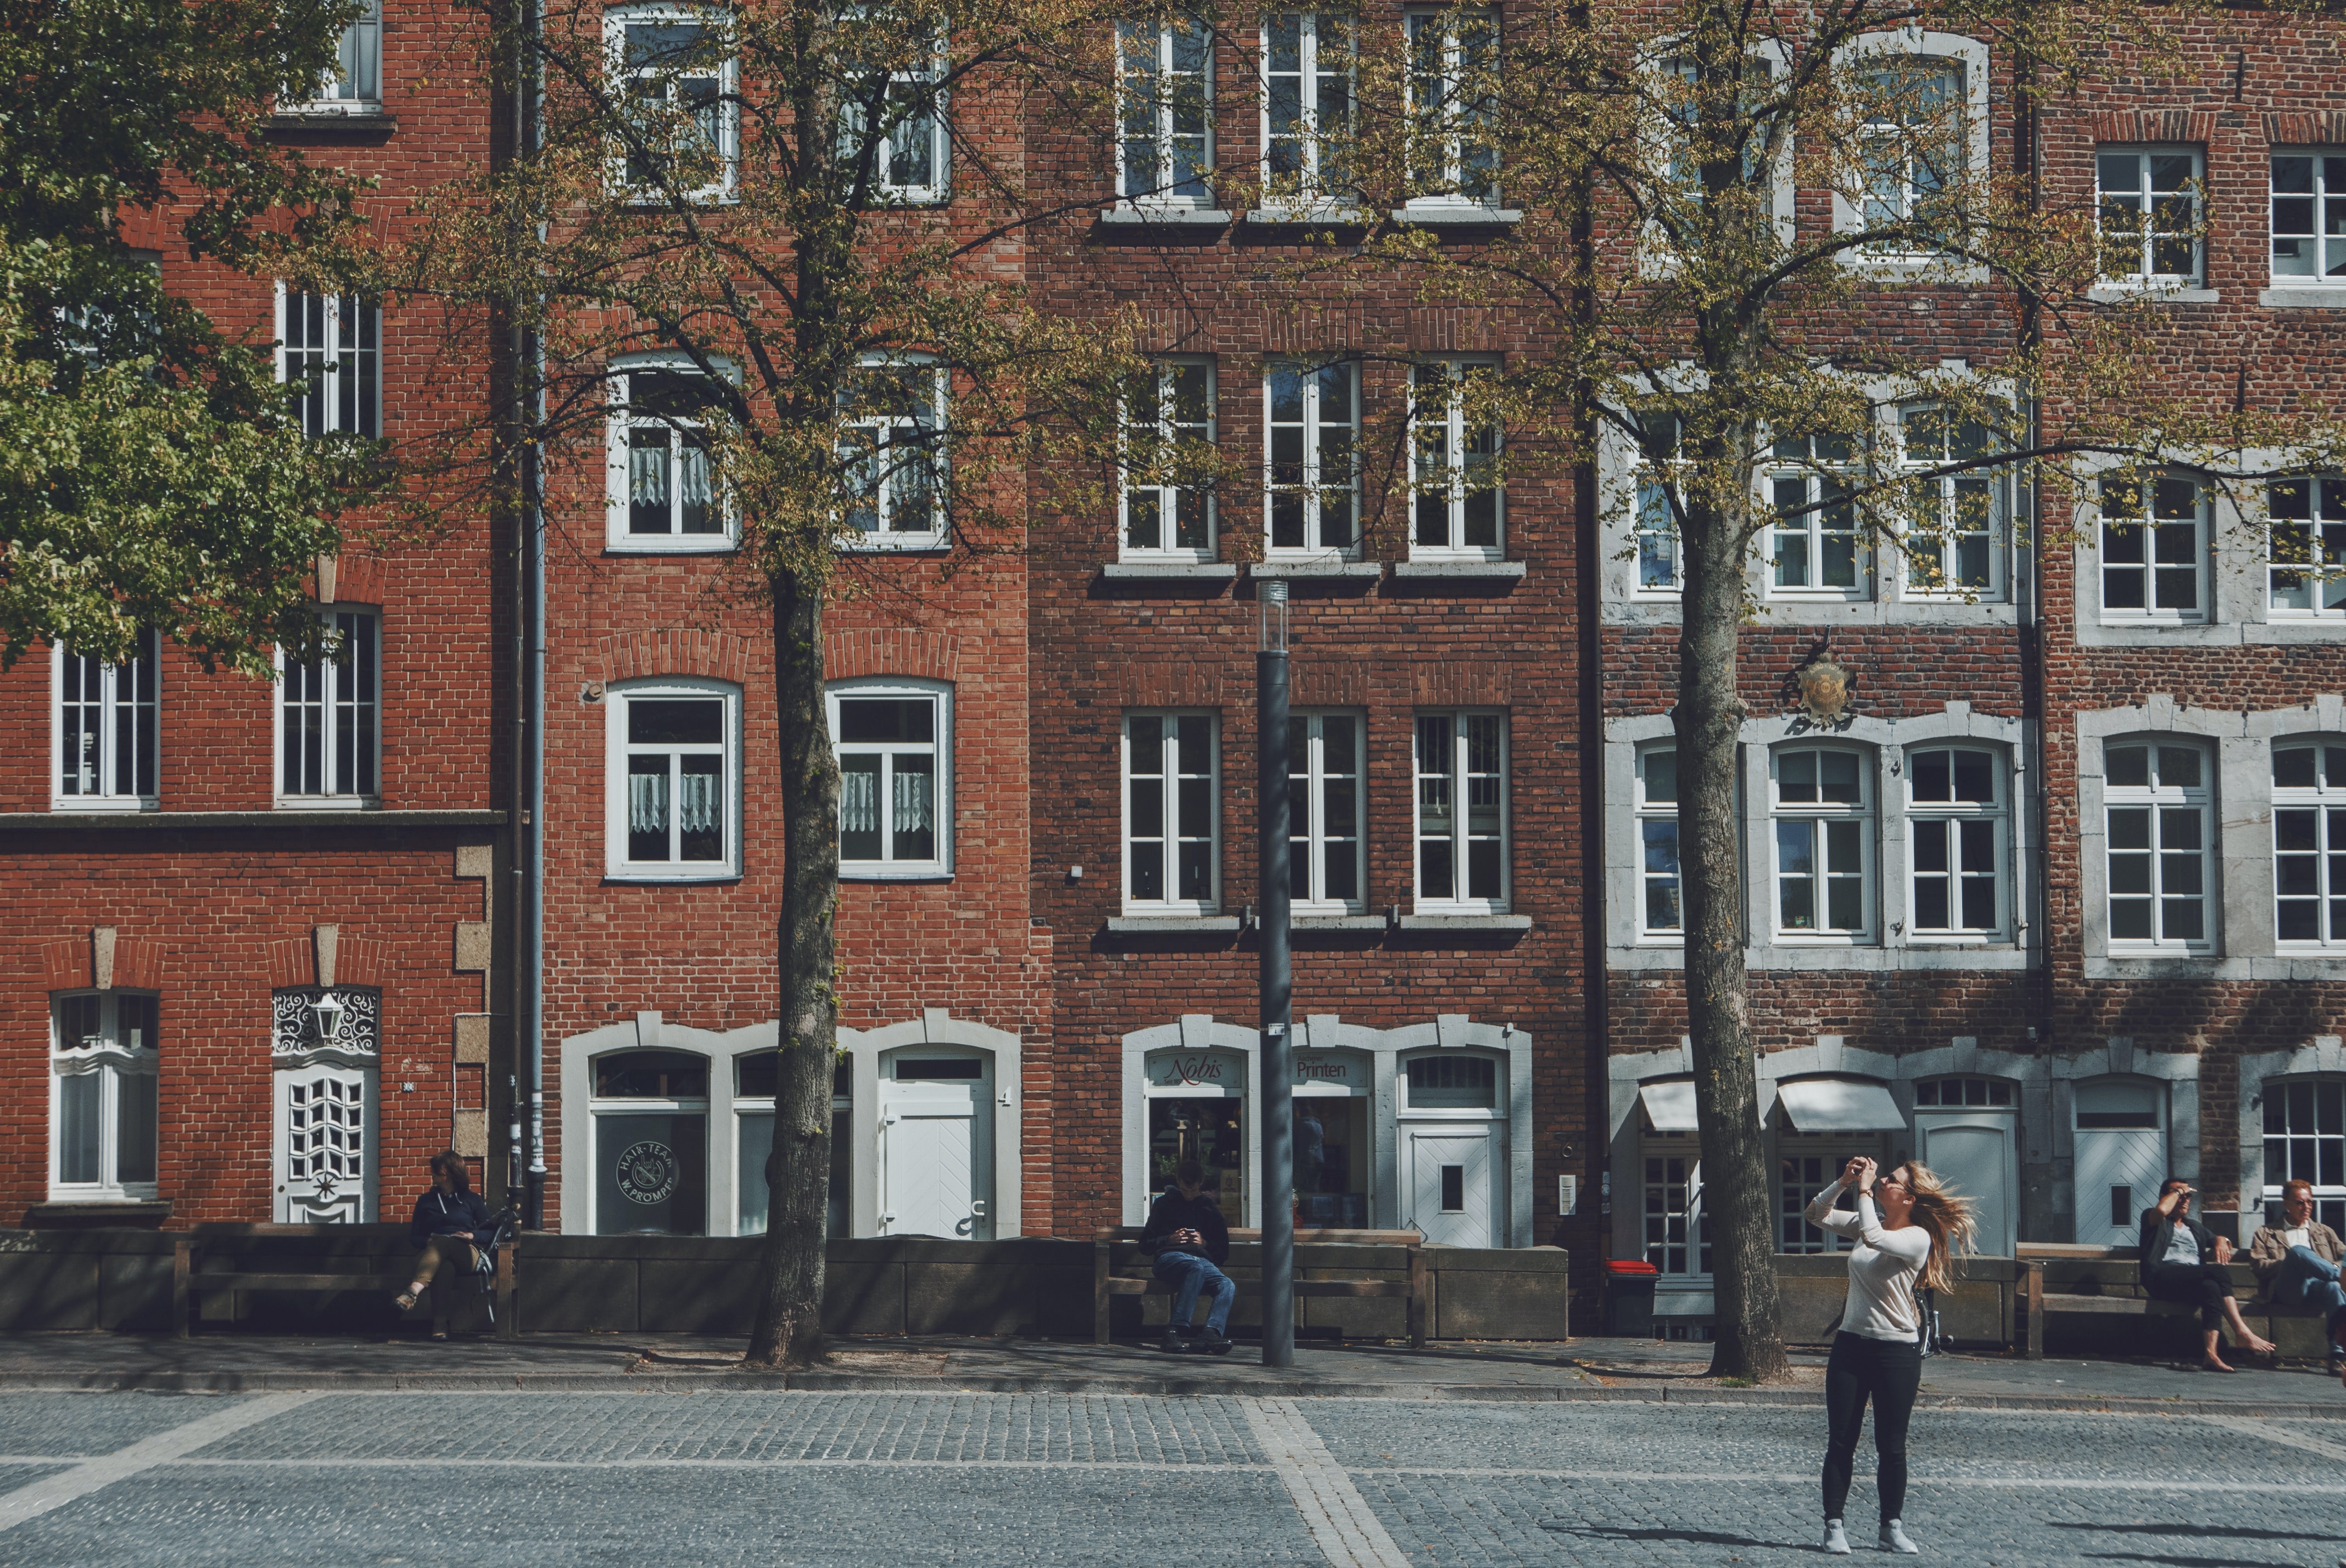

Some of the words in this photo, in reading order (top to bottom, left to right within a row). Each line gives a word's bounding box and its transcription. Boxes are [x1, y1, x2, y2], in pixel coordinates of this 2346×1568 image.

[1809, 663, 1823, 675] ANNO
[1164, 1055, 1222, 1085] Nobis
[1298, 1062, 1346, 1077] Printen
[998, 1086, 1012, 1105] 4
[1562, 1142, 1573, 1157] 6
[622, 1179, 632, 1191] W.
